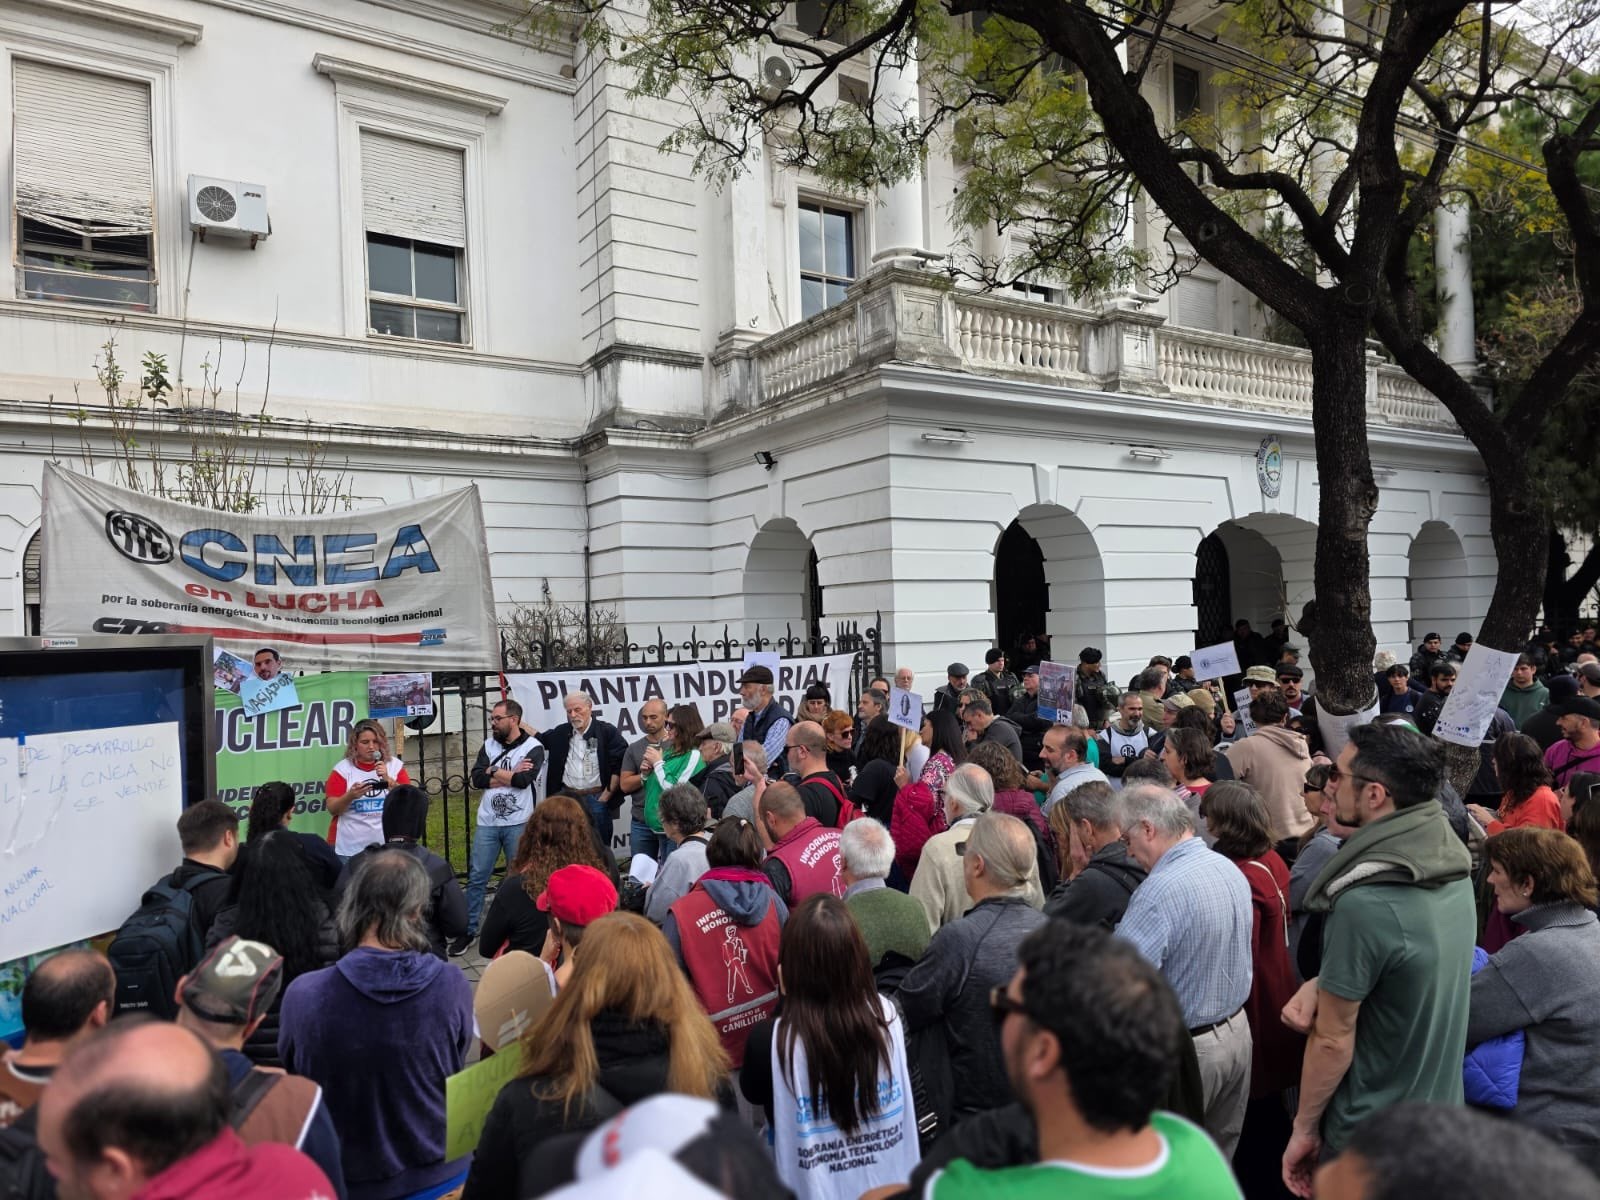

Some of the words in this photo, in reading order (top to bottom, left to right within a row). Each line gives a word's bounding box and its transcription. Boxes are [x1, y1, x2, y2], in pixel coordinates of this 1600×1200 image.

[179, 524, 440, 586] CNEA
[102, 593, 123, 604] por
[126, 594, 138, 606] la
[141, 598, 199, 613] soberanía
[201, 605, 260, 618] energética
[262, 613, 269, 622] y
[402, 607, 443, 621] nacional
[185, 583, 232, 603] en
[246, 589, 384, 614] LUCHA
[674, 662, 831, 699] INDURIAL
[64, 738, 154, 764] DESARROLLO
[81, 763, 138, 788] CNEA
[150, 752, 175, 772] NO
[722, 1011, 767, 1033] CANILLITAS
[829, 1155, 877, 1174] NACIONAL
